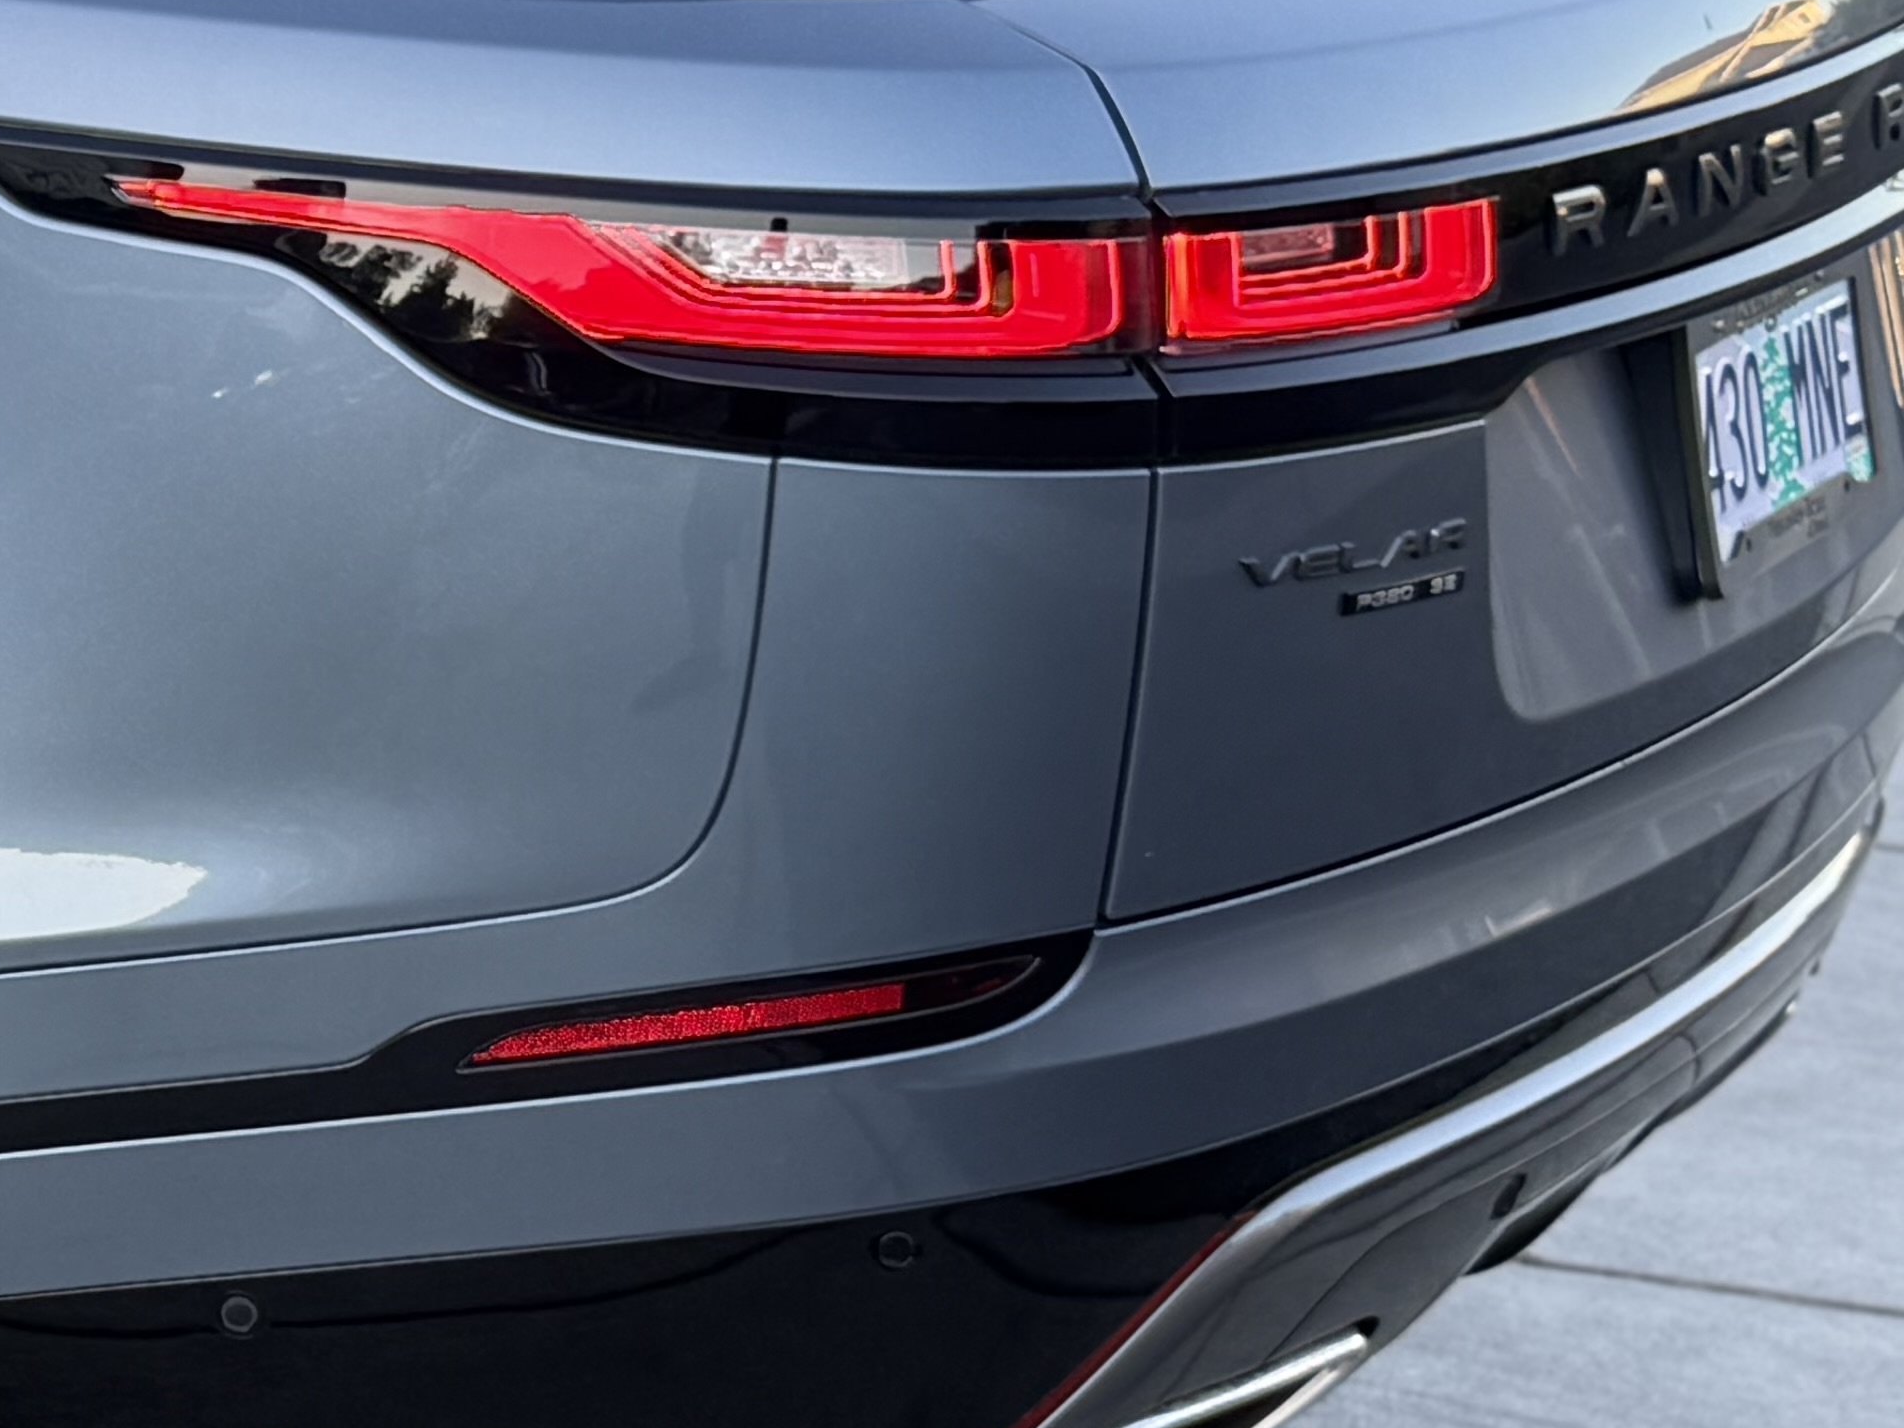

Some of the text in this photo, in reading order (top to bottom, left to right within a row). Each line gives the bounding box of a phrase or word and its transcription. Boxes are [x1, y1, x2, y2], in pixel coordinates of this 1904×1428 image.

[1550, 109, 1848, 258] RANGE
[1782, 301, 1866, 469] MNE
[1238, 516, 1468, 588] VELAR
